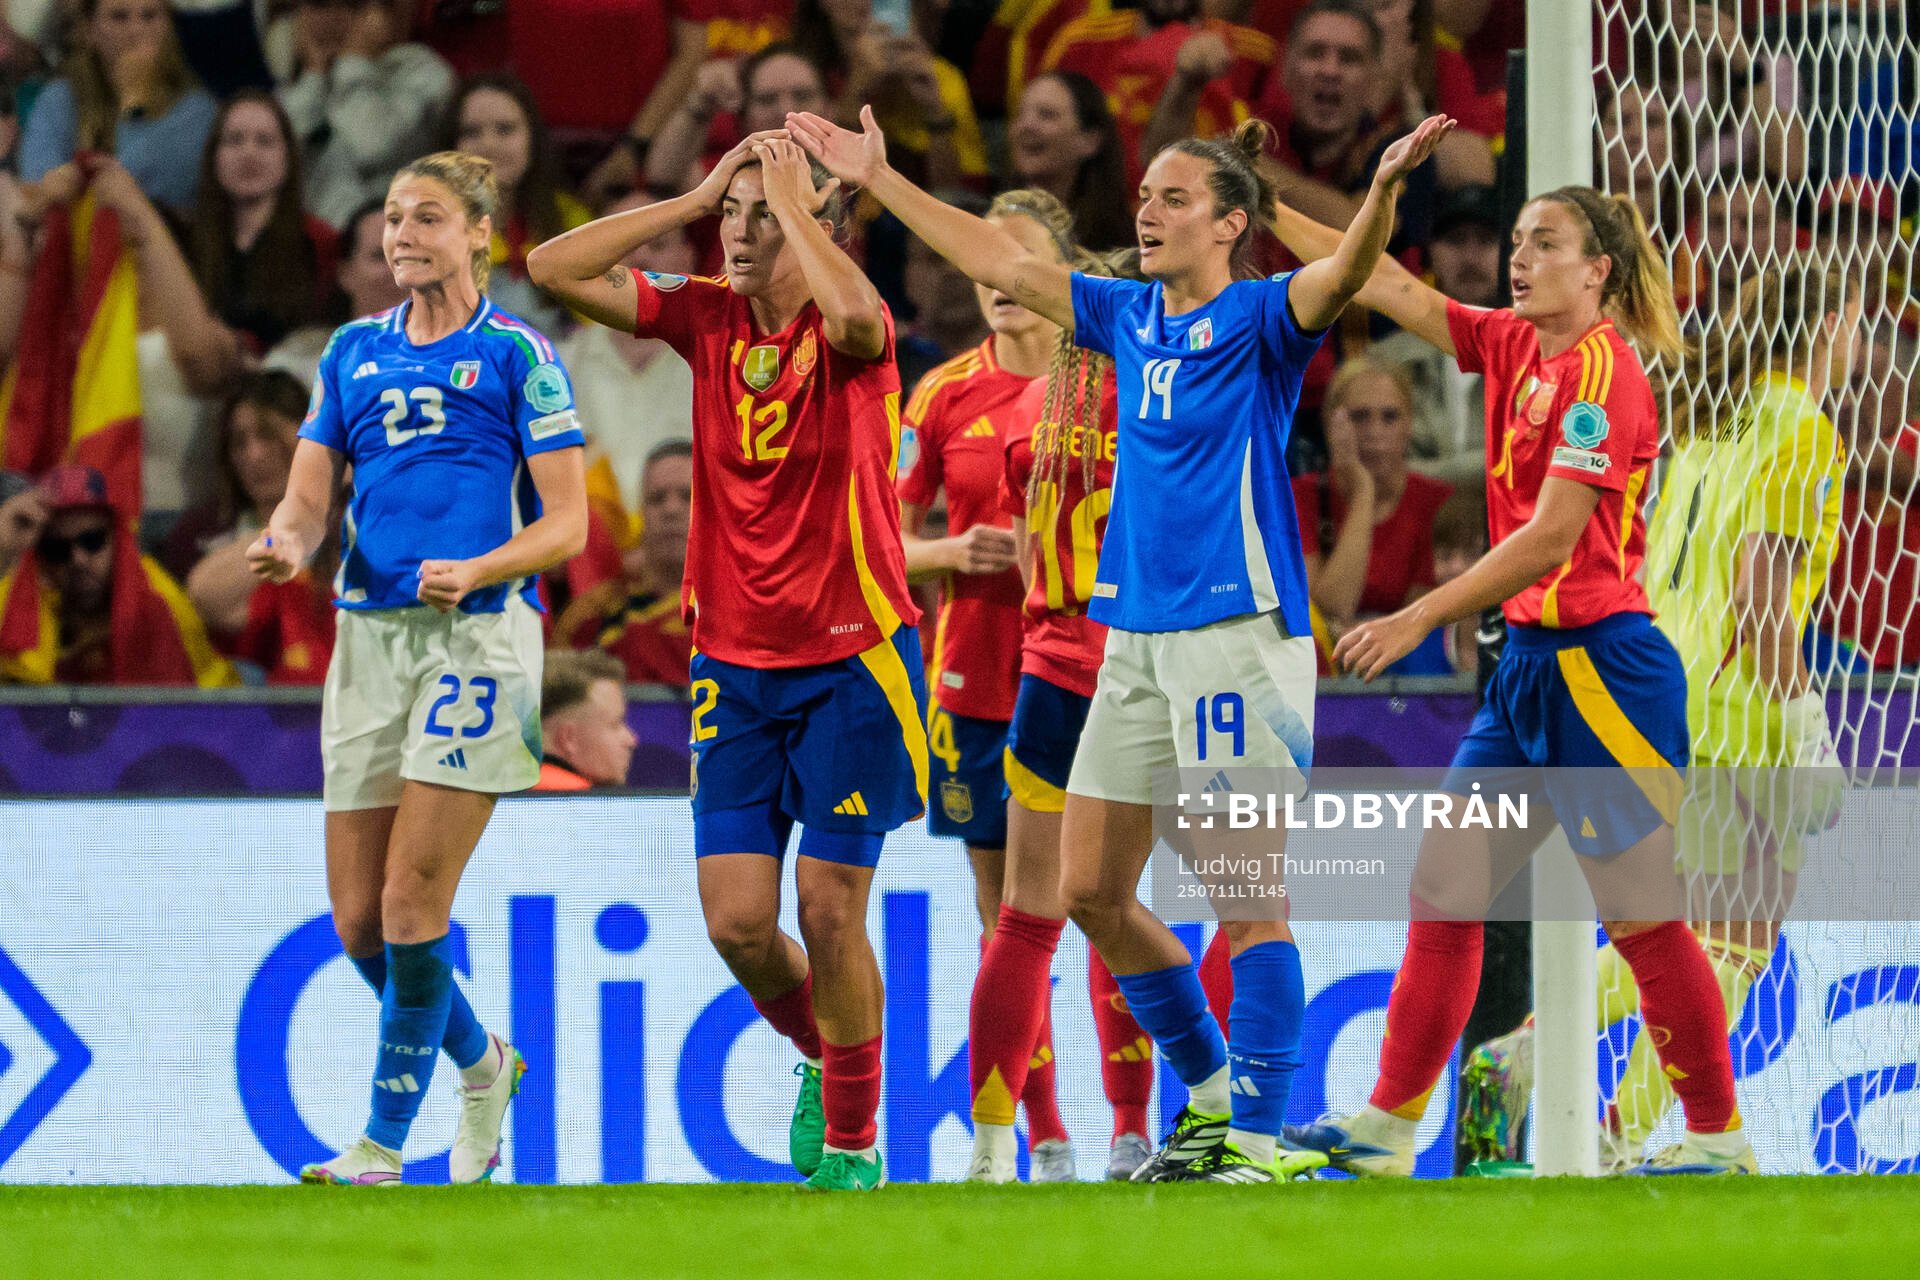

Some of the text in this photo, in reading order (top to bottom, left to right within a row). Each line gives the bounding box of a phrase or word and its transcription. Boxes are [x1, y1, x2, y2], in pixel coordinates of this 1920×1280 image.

[380, 386, 446, 447] 23
[1138, 358, 1182, 420] 19
[736, 393, 789, 460] 12
[424, 673, 497, 738] 23
[690, 678, 721, 744] 2
[1195, 692, 1245, 761] 19
[235, 889, 1060, 1183] Click
